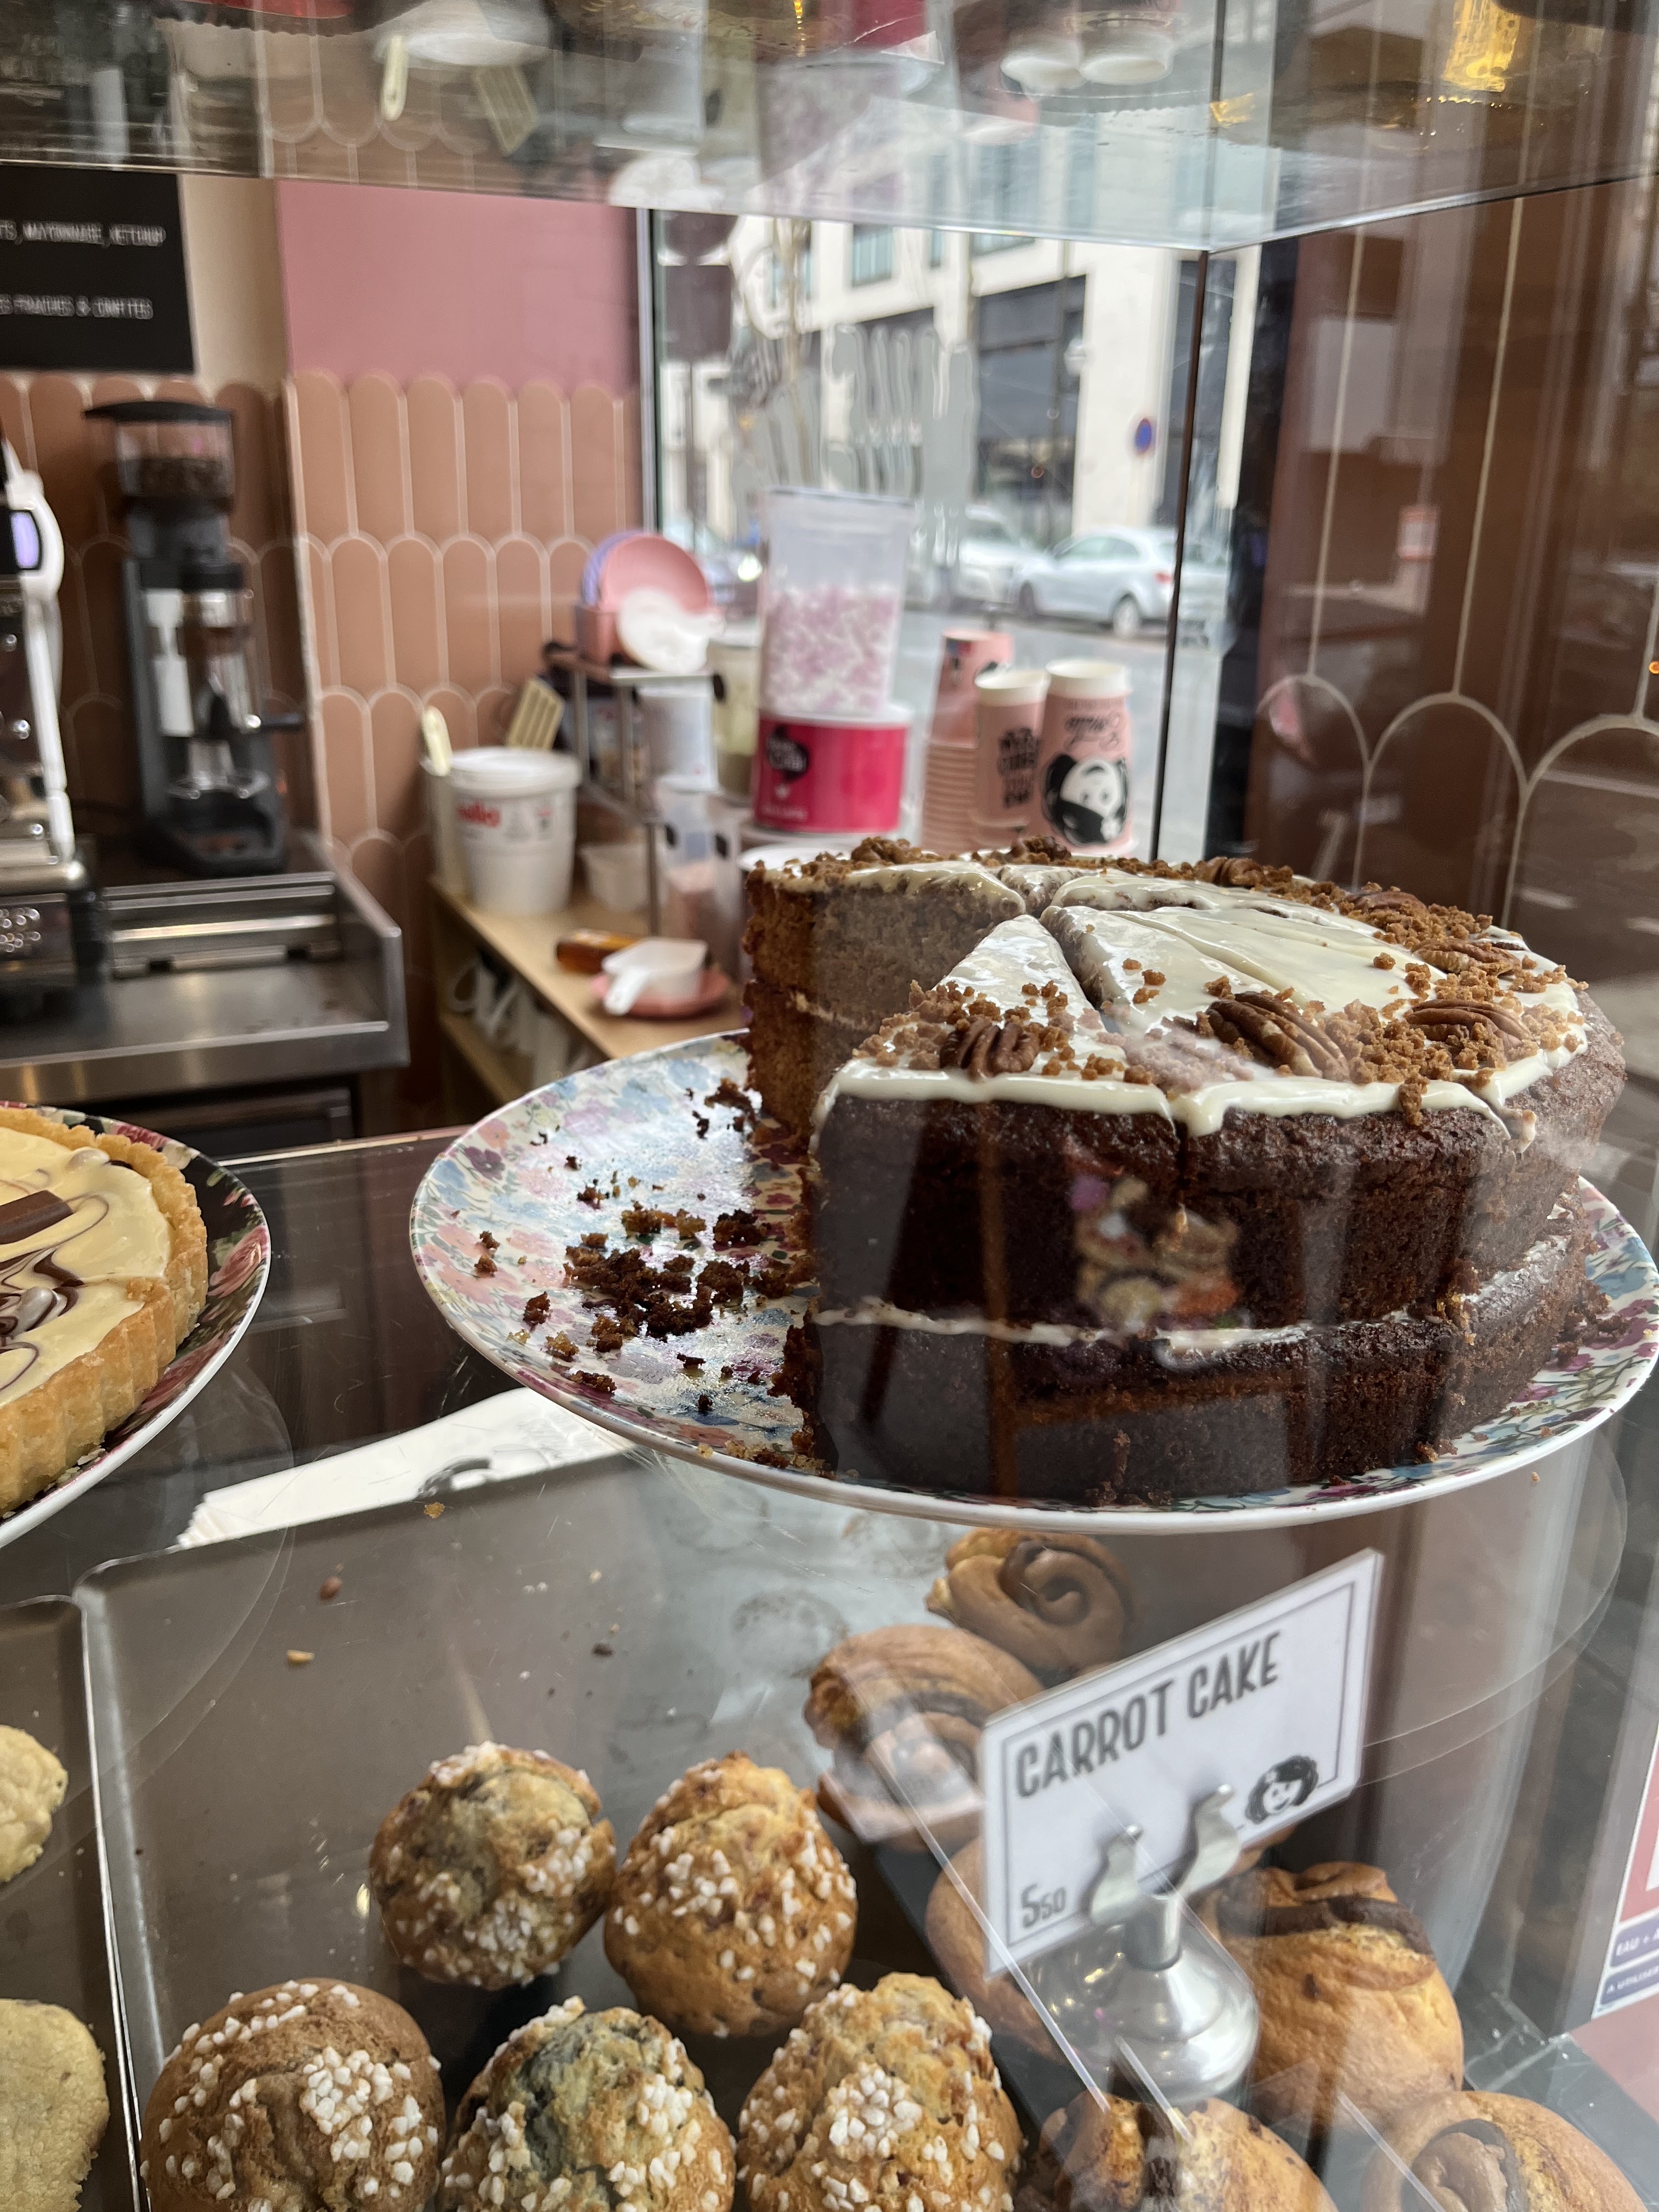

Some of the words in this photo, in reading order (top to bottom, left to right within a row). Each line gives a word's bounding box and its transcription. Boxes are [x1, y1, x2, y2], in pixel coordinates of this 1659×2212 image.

[1015, 1679, 1176, 1798] CARROT
[1187, 1630, 1282, 1719] CAKE
[1616, 1937, 1640, 1956] EAU
